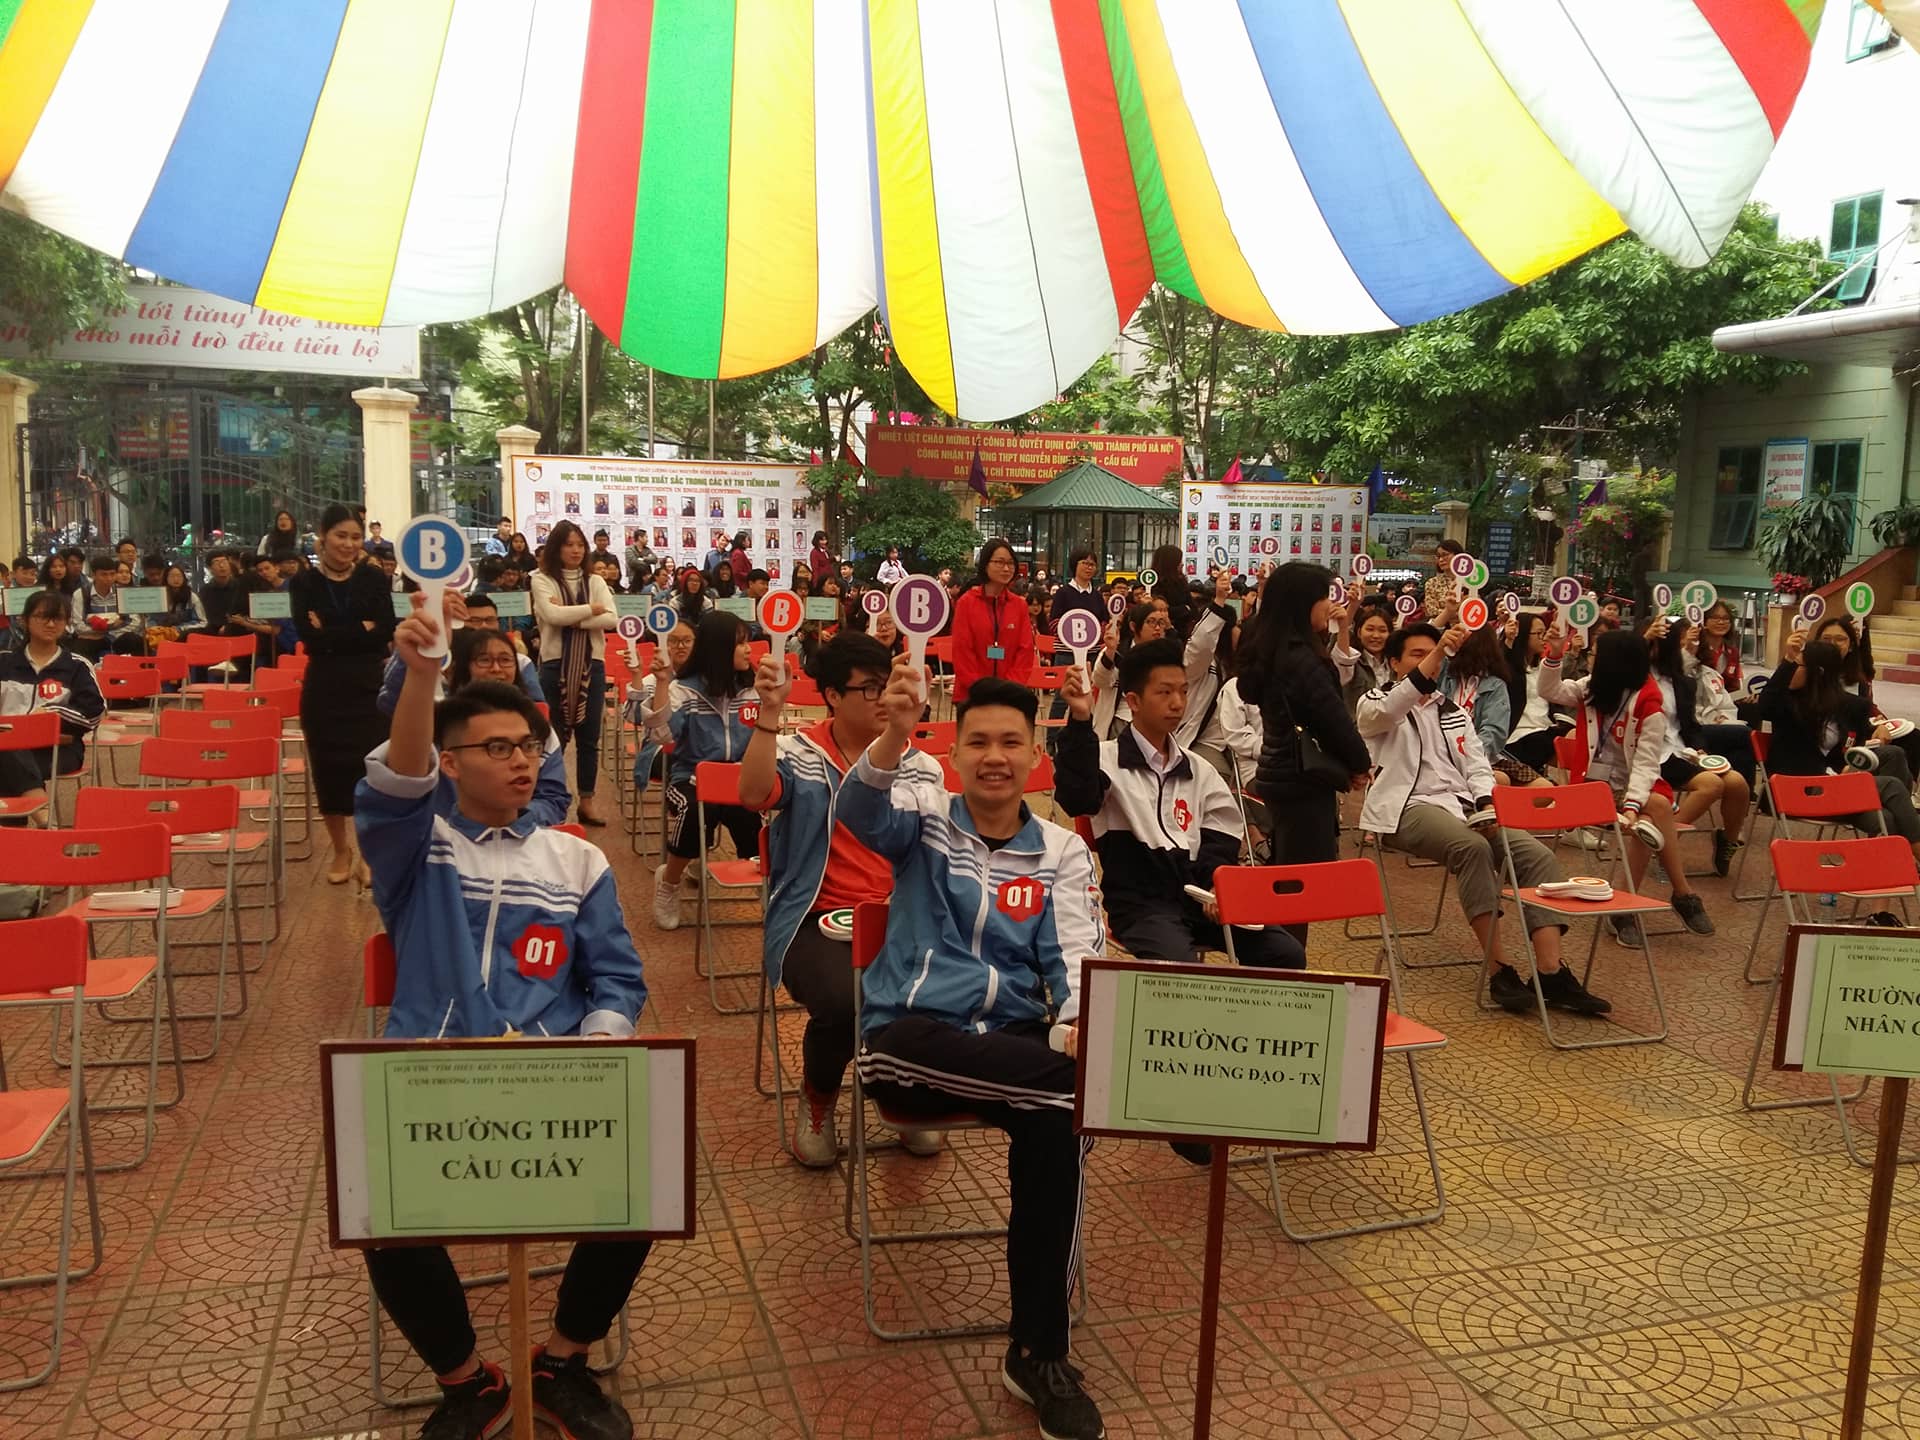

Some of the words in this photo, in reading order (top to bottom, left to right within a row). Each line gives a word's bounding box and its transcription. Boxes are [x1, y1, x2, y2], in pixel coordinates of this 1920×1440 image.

[138, 301, 173, 320] tới
[183, 304, 245, 328] từng
[258, 308, 301, 331] học
[129, 326, 180, 346] mỗi
[192, 331, 227, 349] trò
[238, 332, 284, 352] đều
[294, 336, 338, 356] tiến
[352, 339, 380, 363] bộ
[922, 433, 944, 444] CHÀO
[946, 434, 970, 445] MỪNG
[984, 436, 1005, 447] CÔNG
[1020, 438, 1043, 449] QUYẾT
[1106, 440, 1130, 452] THÀNH
[1132, 440, 1147, 452] PHỐ
[918, 448, 939, 459] CÔNG
[999, 452, 1017, 463] THPT
[1006, 468, 1036, 478] TRƯỜNG
[419, 530, 446, 570] B
[1265, 540, 1274, 553] B
[1359, 558, 1367, 572] B
[1457, 558, 1469, 573] B
[1145, 573, 1152, 583] C
[1328, 586, 1337, 600] B
[1559, 583, 1572, 601] B
[1694, 589, 1705, 605] B
[1856, 590, 1866, 609] B
[772, 598, 790, 627] B
[870, 596, 880, 611] B
[910, 588, 930, 624] B
[1114, 600, 1121, 612] B
[1402, 599, 1410, 611] B
[1510, 598, 1516, 610] B
[1808, 600, 1819, 617] B
[656, 611, 668, 629] B
[1468, 605, 1481, 623] C
[1576, 604, 1588, 622] B
[1692, 608, 1698, 620] B
[625, 620, 637, 636] B
[1072, 618, 1088, 643] B
[42, 684, 57, 694] 10
[743, 708, 758, 720] 04
[1006, 886, 1033, 908] 01
[525, 937, 556, 966] 01
[1844, 1014, 1906, 1035] NHÂN
[1144, 1028, 1249, 1055] TRƯỜNG
[1256, 1038, 1320, 1060] THPT
[1142, 1057, 1188, 1076] TRẦN
[1194, 1064, 1244, 1081] HƯNG
[1249, 1069, 1285, 1086] ĐẠO
[1299, 1072, 1322, 1086] TX
[404, 1116, 533, 1143] TRƯỜNG
[540, 1118, 618, 1140] THPT
[441, 1154, 502, 1180] CẦU
[510, 1152, 584, 1179] GIẤY
